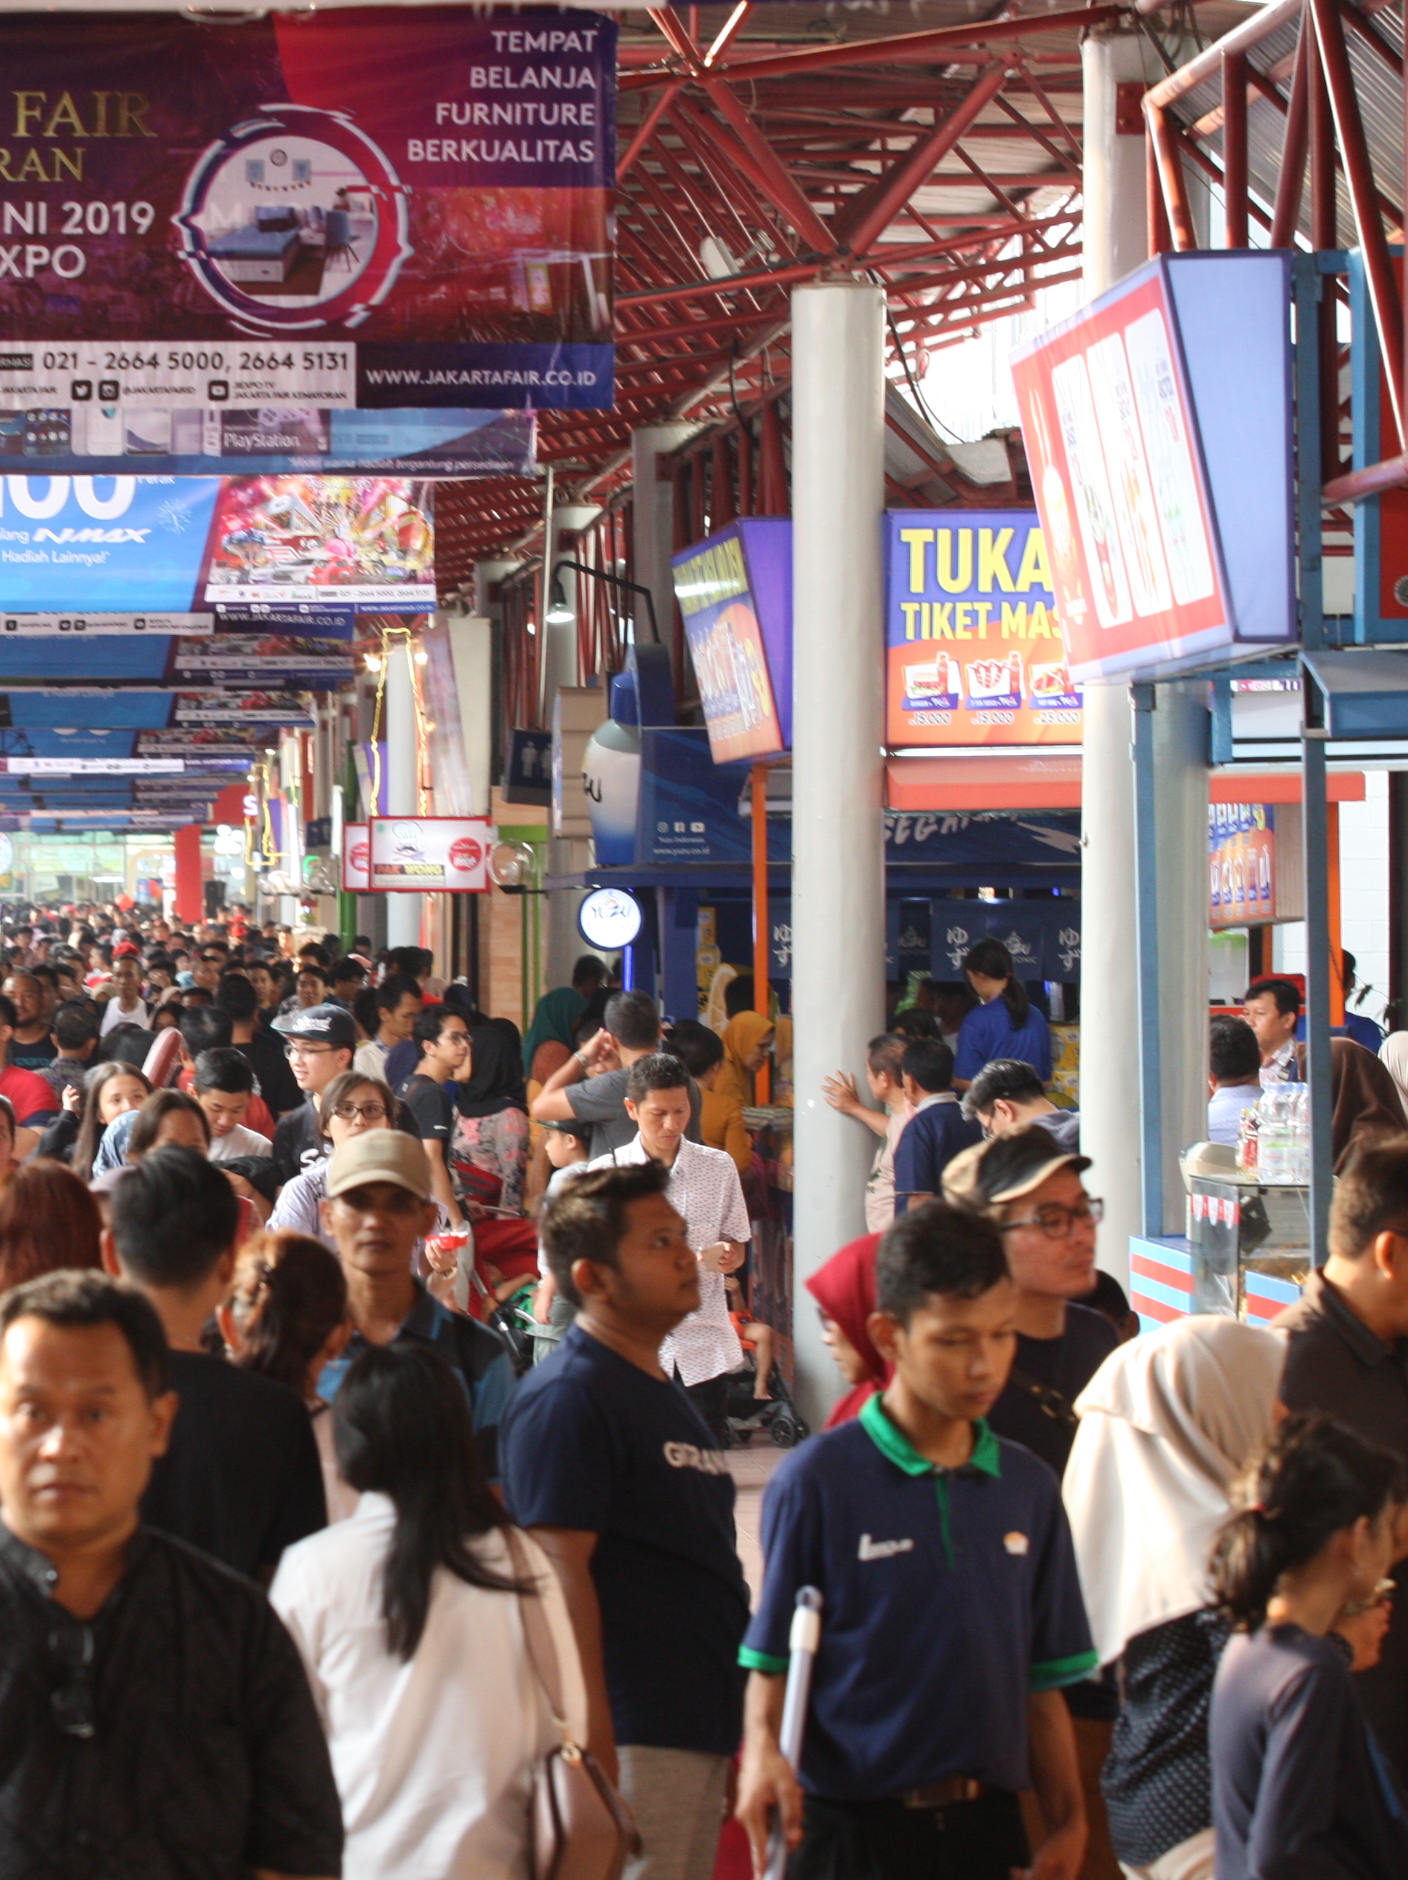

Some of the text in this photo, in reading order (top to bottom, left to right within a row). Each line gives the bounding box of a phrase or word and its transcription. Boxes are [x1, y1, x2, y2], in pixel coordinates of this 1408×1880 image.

[492, 30, 598, 54] TEMPAT
[470, 65, 597, 90] BELANJA
[12, 92, 157, 138] FAIR
[436, 102, 596, 127] FURNITURE
[407, 139, 595, 164] BERKUALITAS
[63, 201, 155, 236] 2019
[43, 352, 78, 370] 021
[105, 352, 160, 369] 2664
[168, 352, 231, 374] 5000,
[238, 352, 295, 369] 2664
[302, 352, 349, 370] 5131
[366, 369, 597, 388] WWW.JAKARTAFAIR.CO.ID
[223, 432, 300, 452] PlayStation
[2, 549, 49, 563] Hadiah
[901, 603, 989, 641] TIKET
